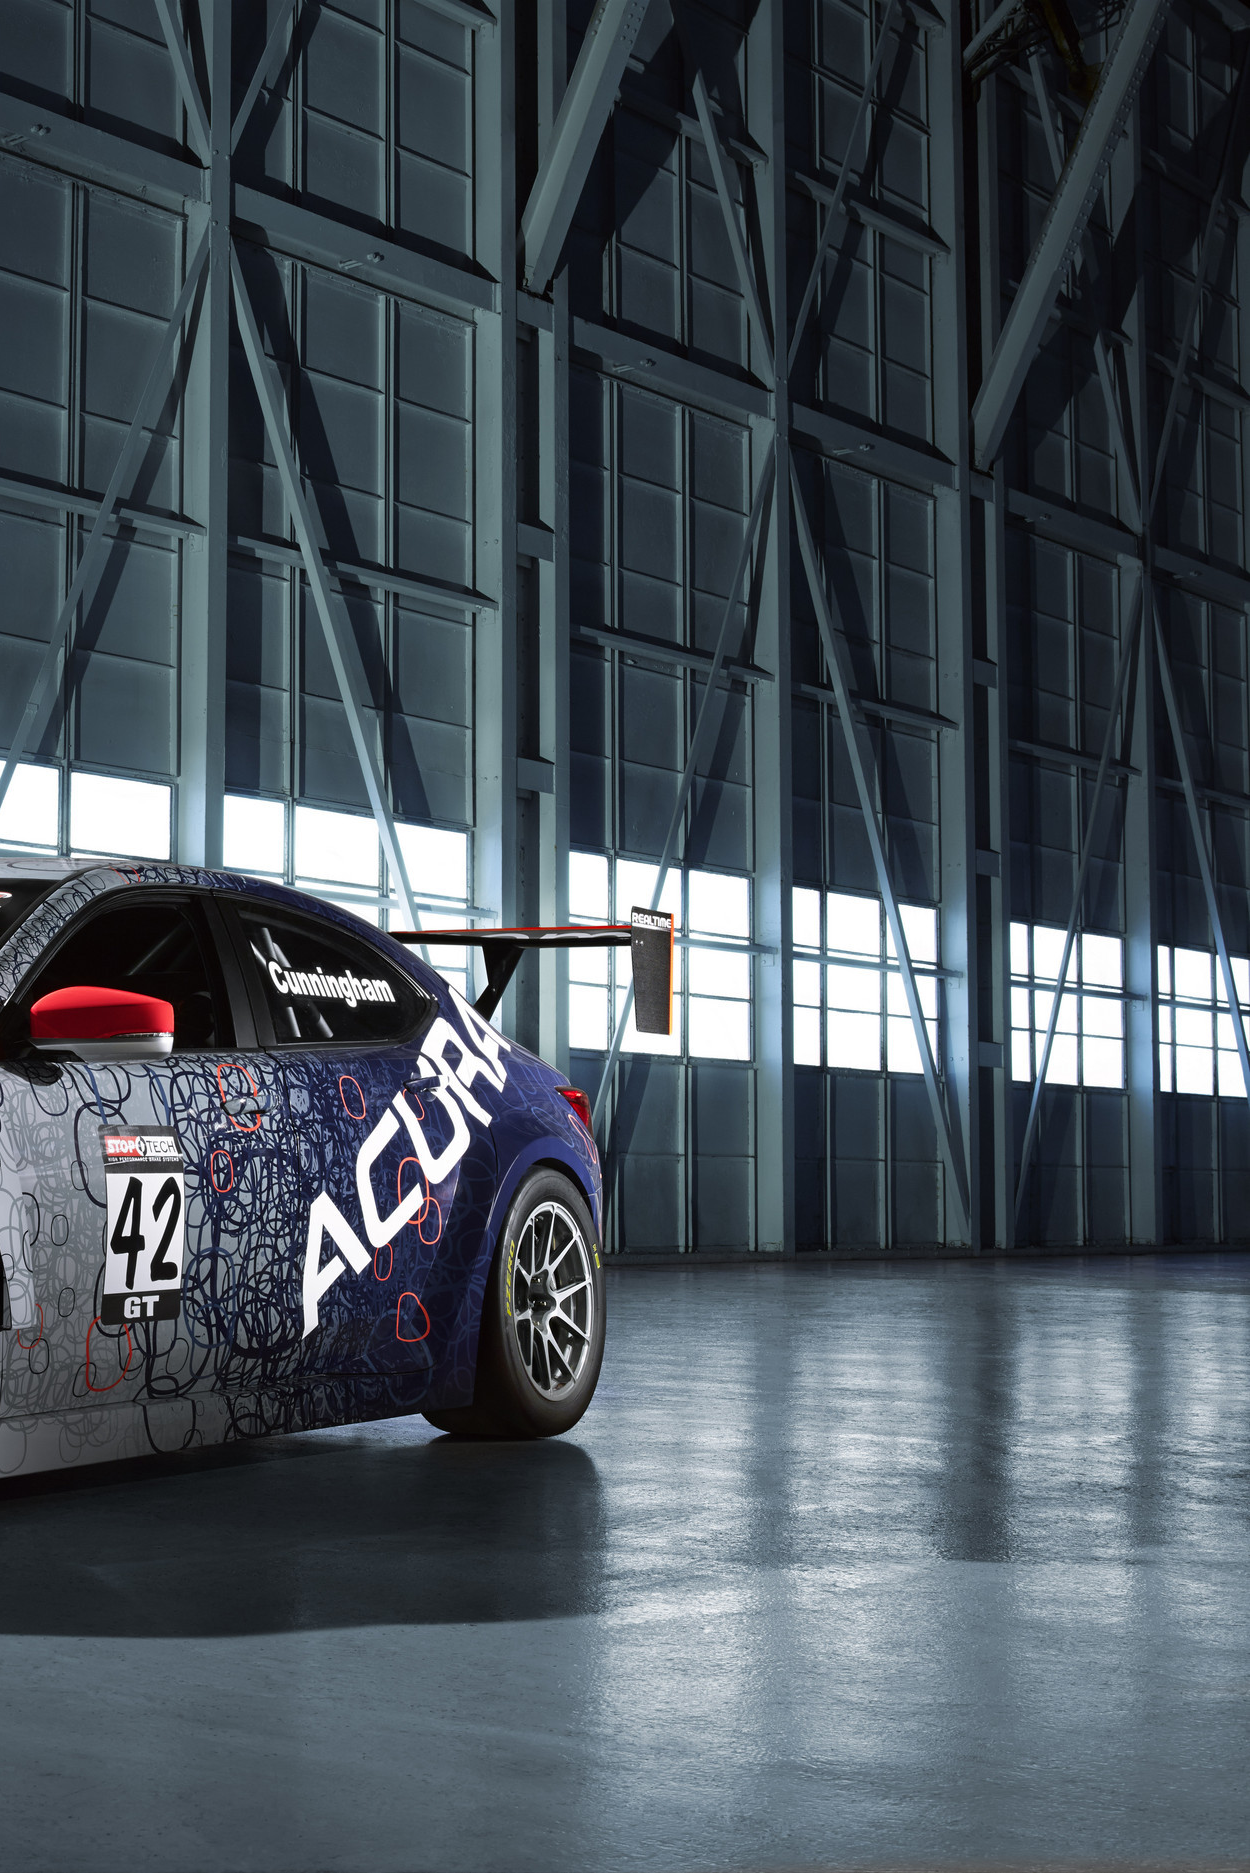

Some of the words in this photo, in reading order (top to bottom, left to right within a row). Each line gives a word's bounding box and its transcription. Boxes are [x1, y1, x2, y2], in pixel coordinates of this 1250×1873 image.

[632, 912, 672, 928] REALTIME
[268, 961, 396, 1008] Cunningham
[302, 986, 512, 1340] ACURA
[110, 1176, 182, 1290] 42
[123, 1295, 160, 1319] GT
